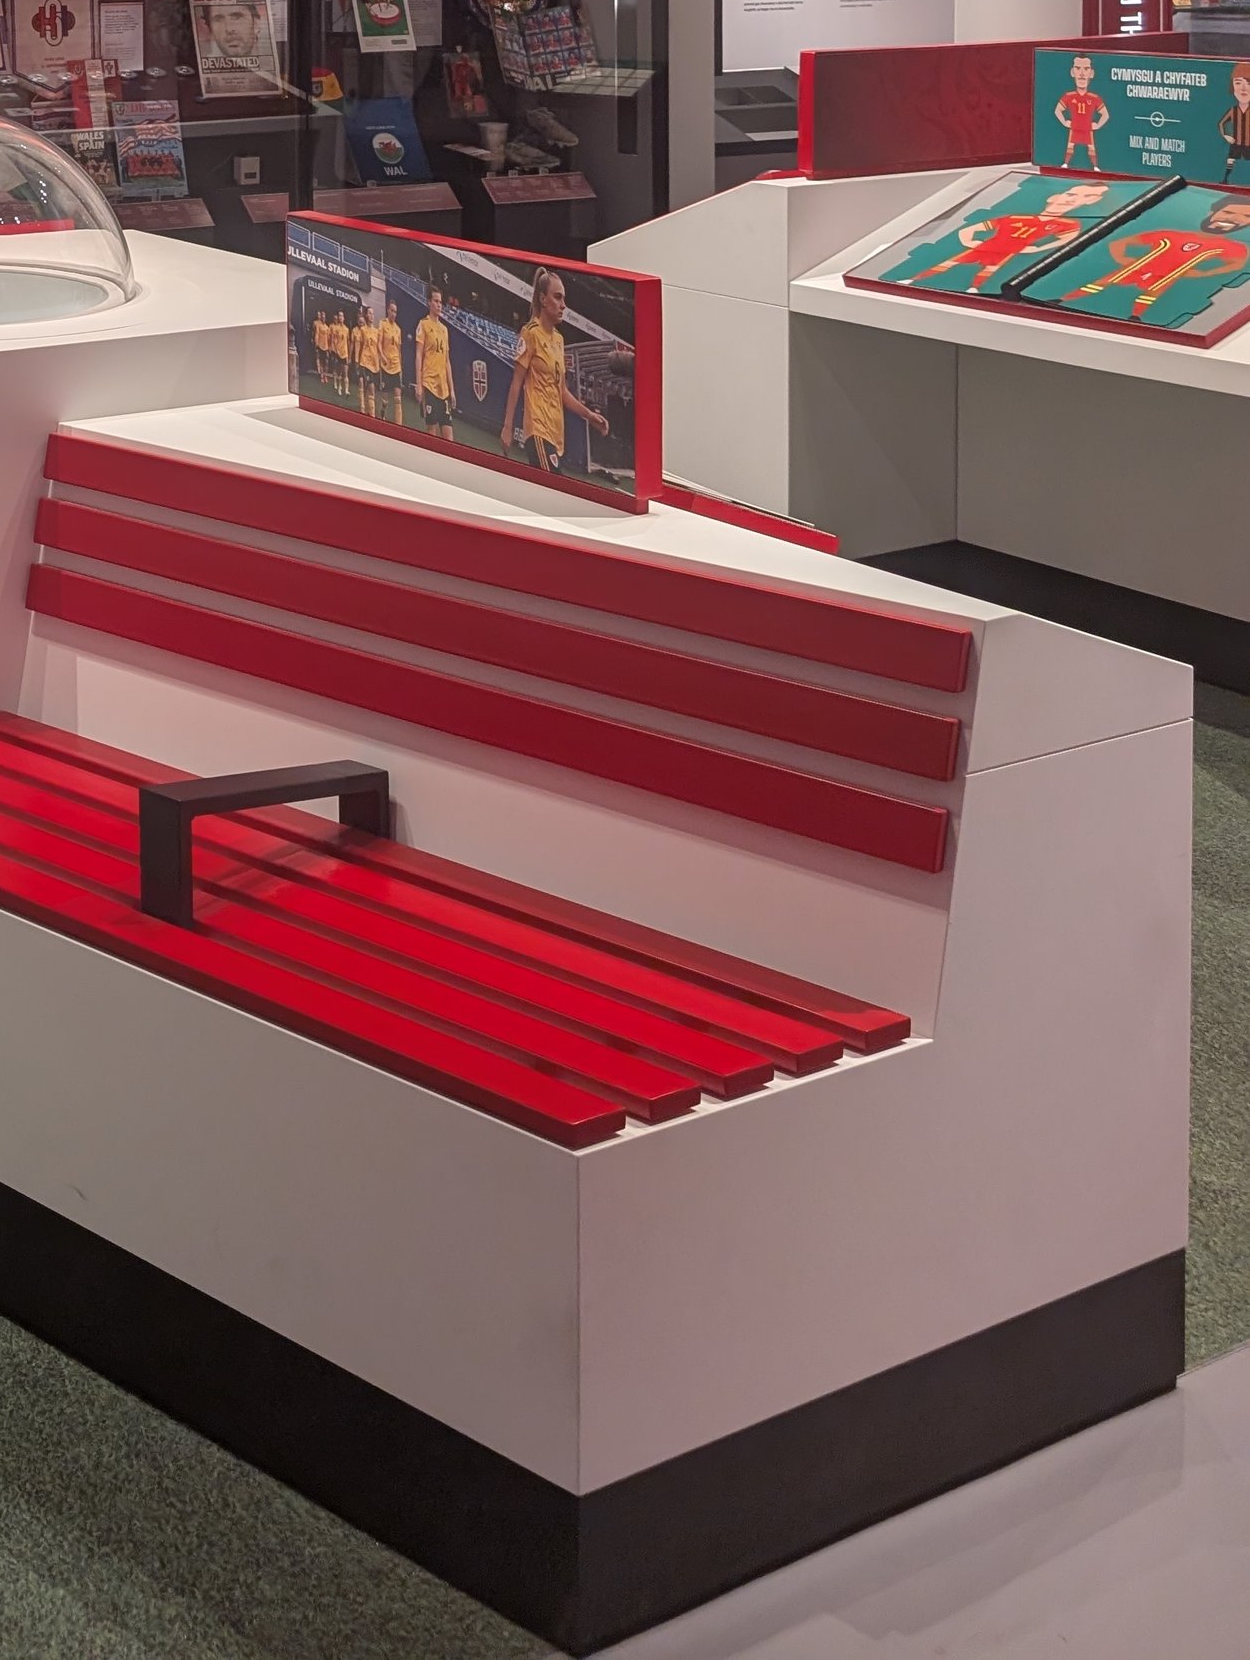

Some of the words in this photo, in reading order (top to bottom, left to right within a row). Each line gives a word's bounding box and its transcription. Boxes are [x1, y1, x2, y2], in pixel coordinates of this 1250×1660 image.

[201, 57, 260, 69] DEVASTATED
[1111, 68, 1154, 83] CYMYSGU
[1155, 71, 1162, 84] A
[1163, 71, 1207, 87] CHYFATEB
[1126, 84, 1190, 102] CHWARAEWYR
[1077, 102, 1087, 115] 11
[76, 131, 104, 141] WALES
[78, 141, 105, 151] SPAIN
[1129, 135, 1144, 149] MIX
[1144, 137, 1159, 151] AND
[1161, 138, 1186, 153] MATCH
[1142, 152, 1172, 167] PLAYERS
[383, 165, 409, 176] WAL
[1010, 223, 1036, 239] 11
[327, 261, 360, 283] STADION
[335, 289, 358, 304] STADION
